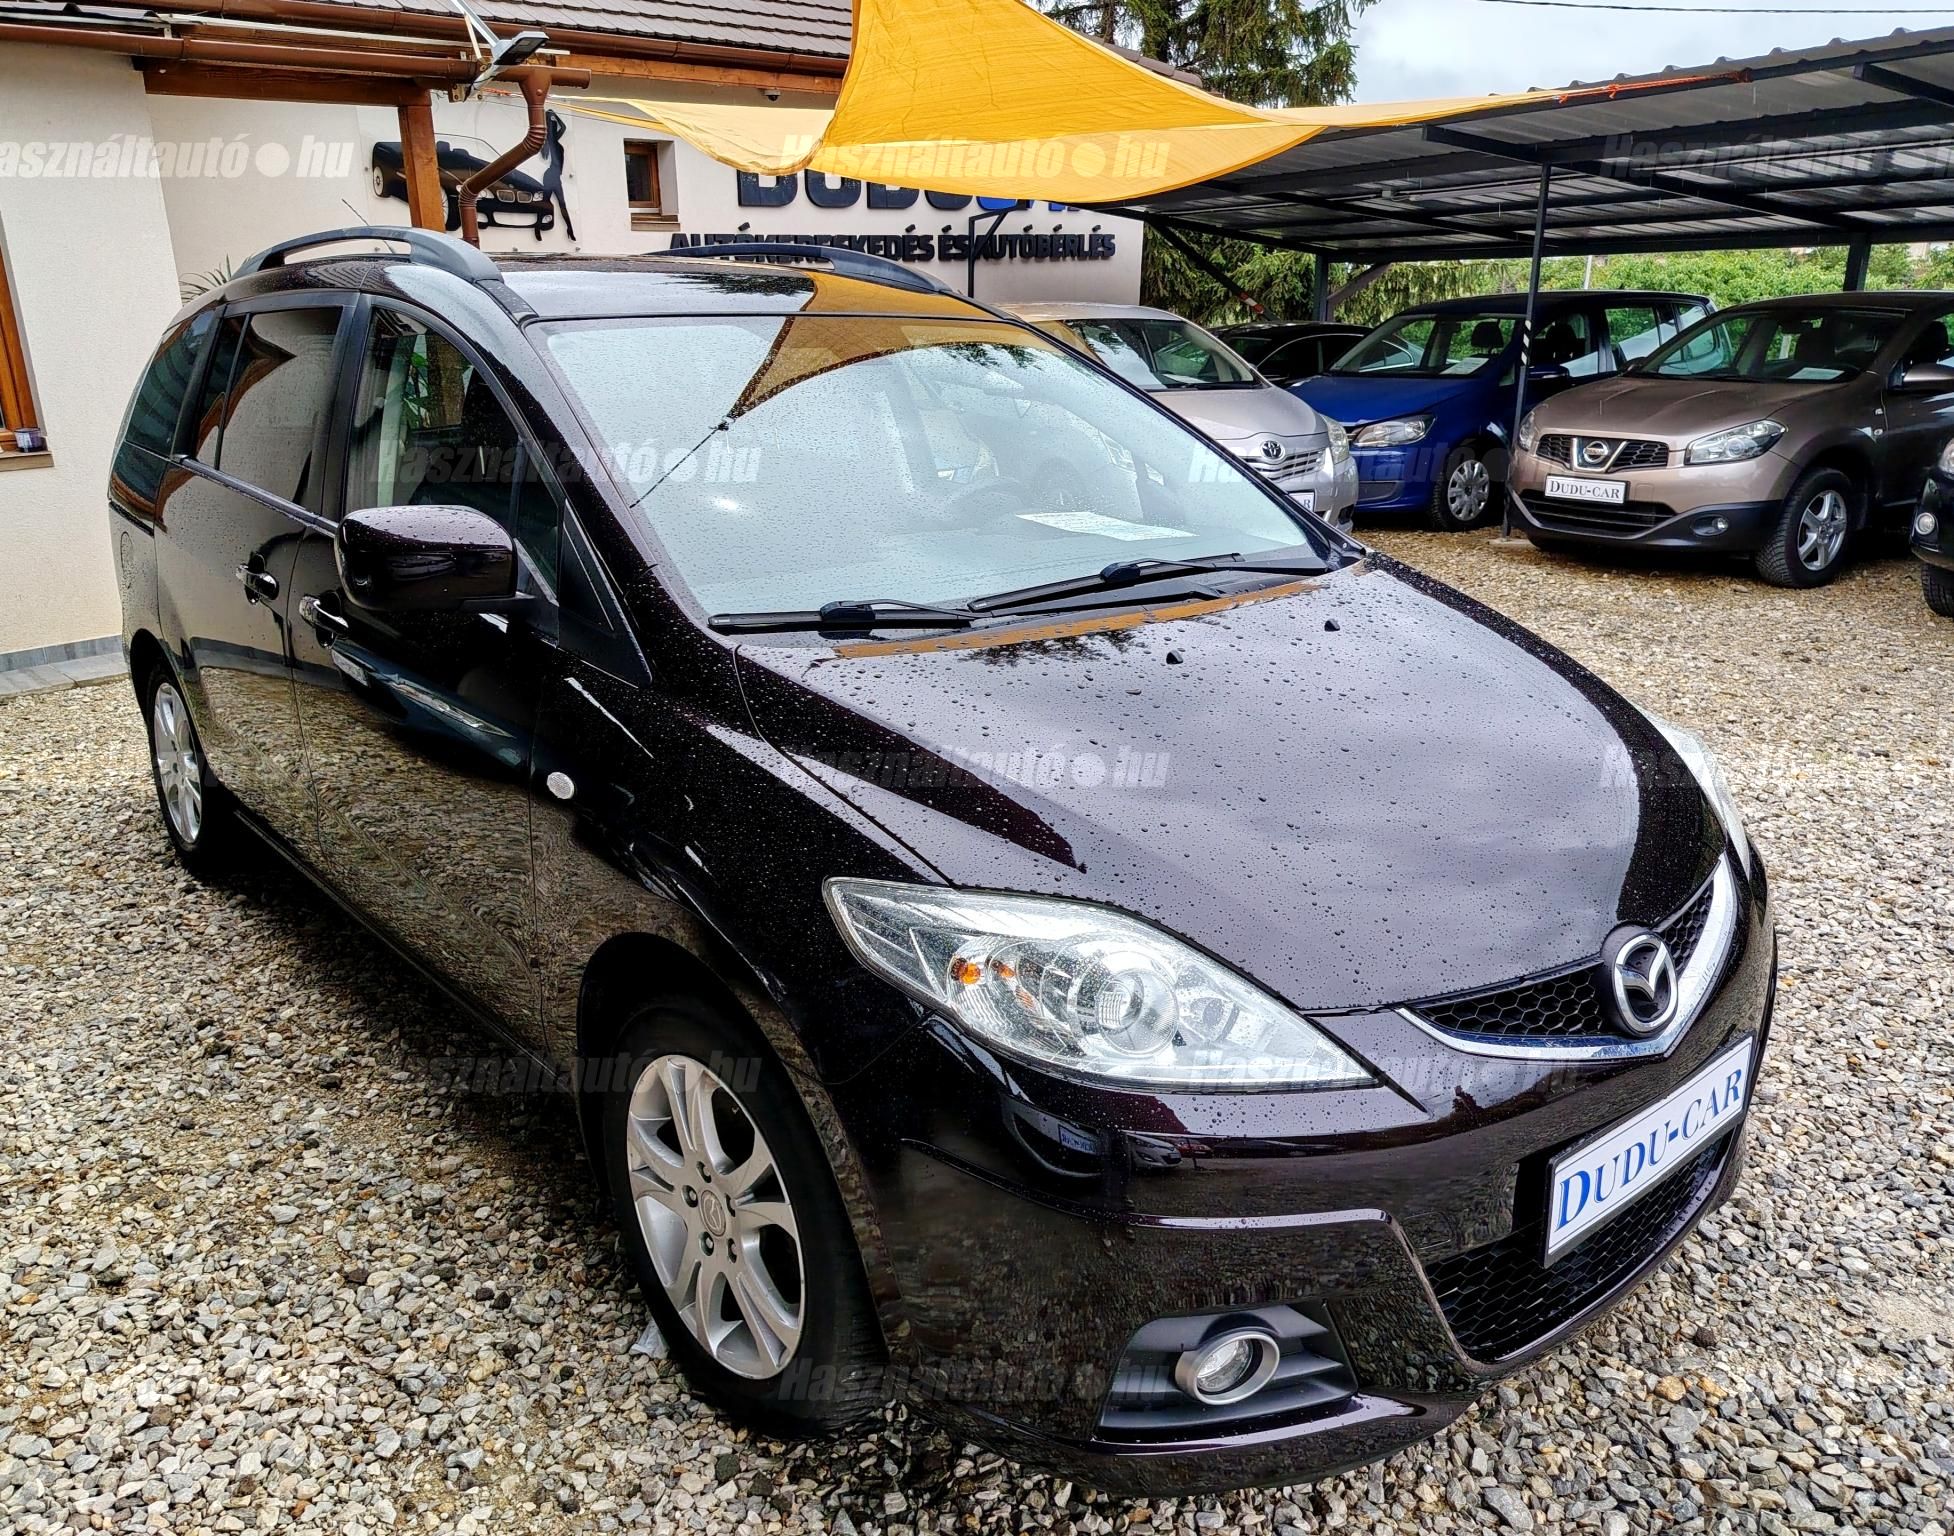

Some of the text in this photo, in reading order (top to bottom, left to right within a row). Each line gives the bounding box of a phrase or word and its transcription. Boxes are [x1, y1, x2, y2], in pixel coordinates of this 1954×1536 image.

[974, 223, 1116, 261] AUTÓBÉRLÉS
[1549, 480, 1621, 499] DUDU-CAR
[1554, 1068, 1743, 1233] DUDU-CAR
